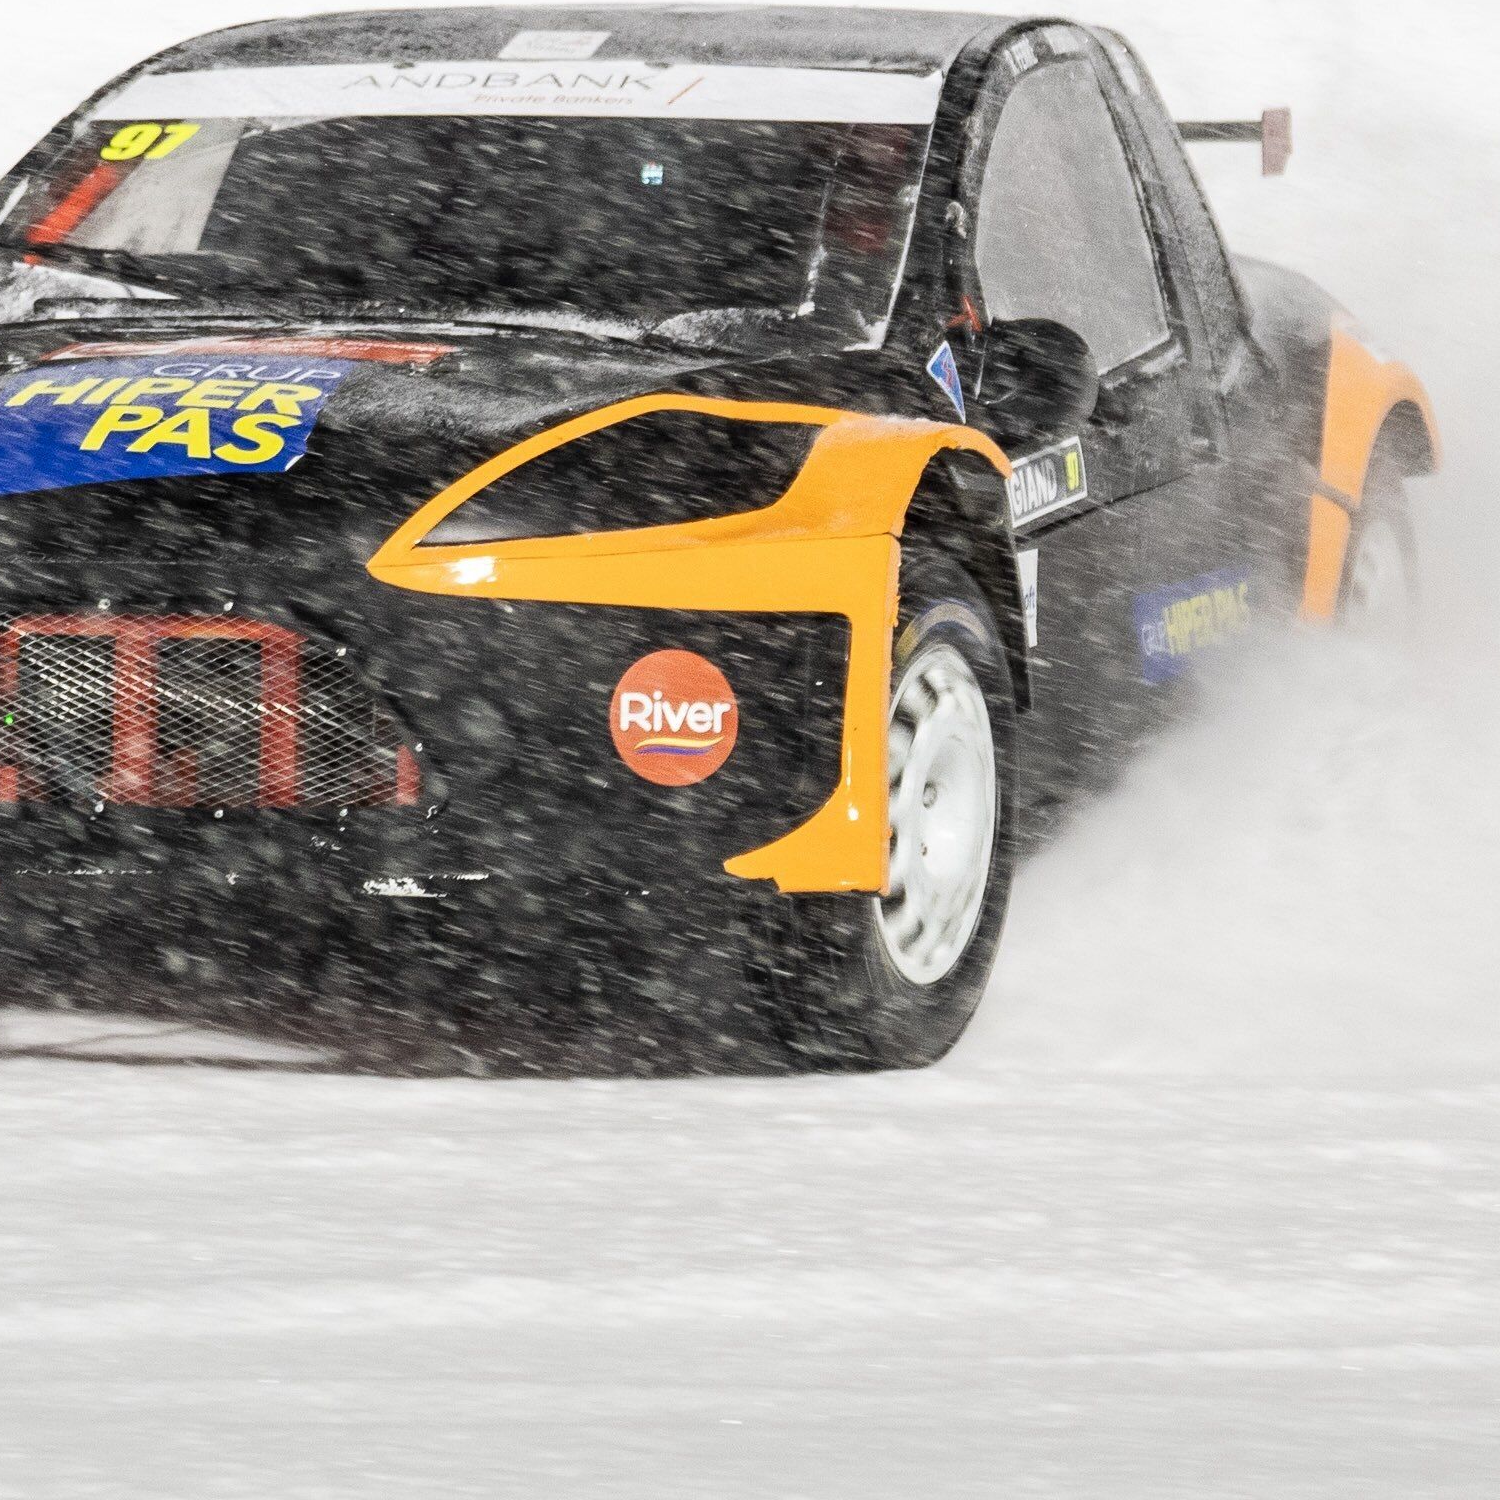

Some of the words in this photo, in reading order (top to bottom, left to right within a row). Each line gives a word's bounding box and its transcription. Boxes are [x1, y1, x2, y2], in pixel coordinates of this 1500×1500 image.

[342, 72, 653, 91] ANDBANK
[100, 123, 200, 161] 97
[152, 362, 342, 383] GRUP
[3, 377, 322, 417] HIPER
[79, 405, 302, 465] PAS
[619, 690, 732, 734] River
